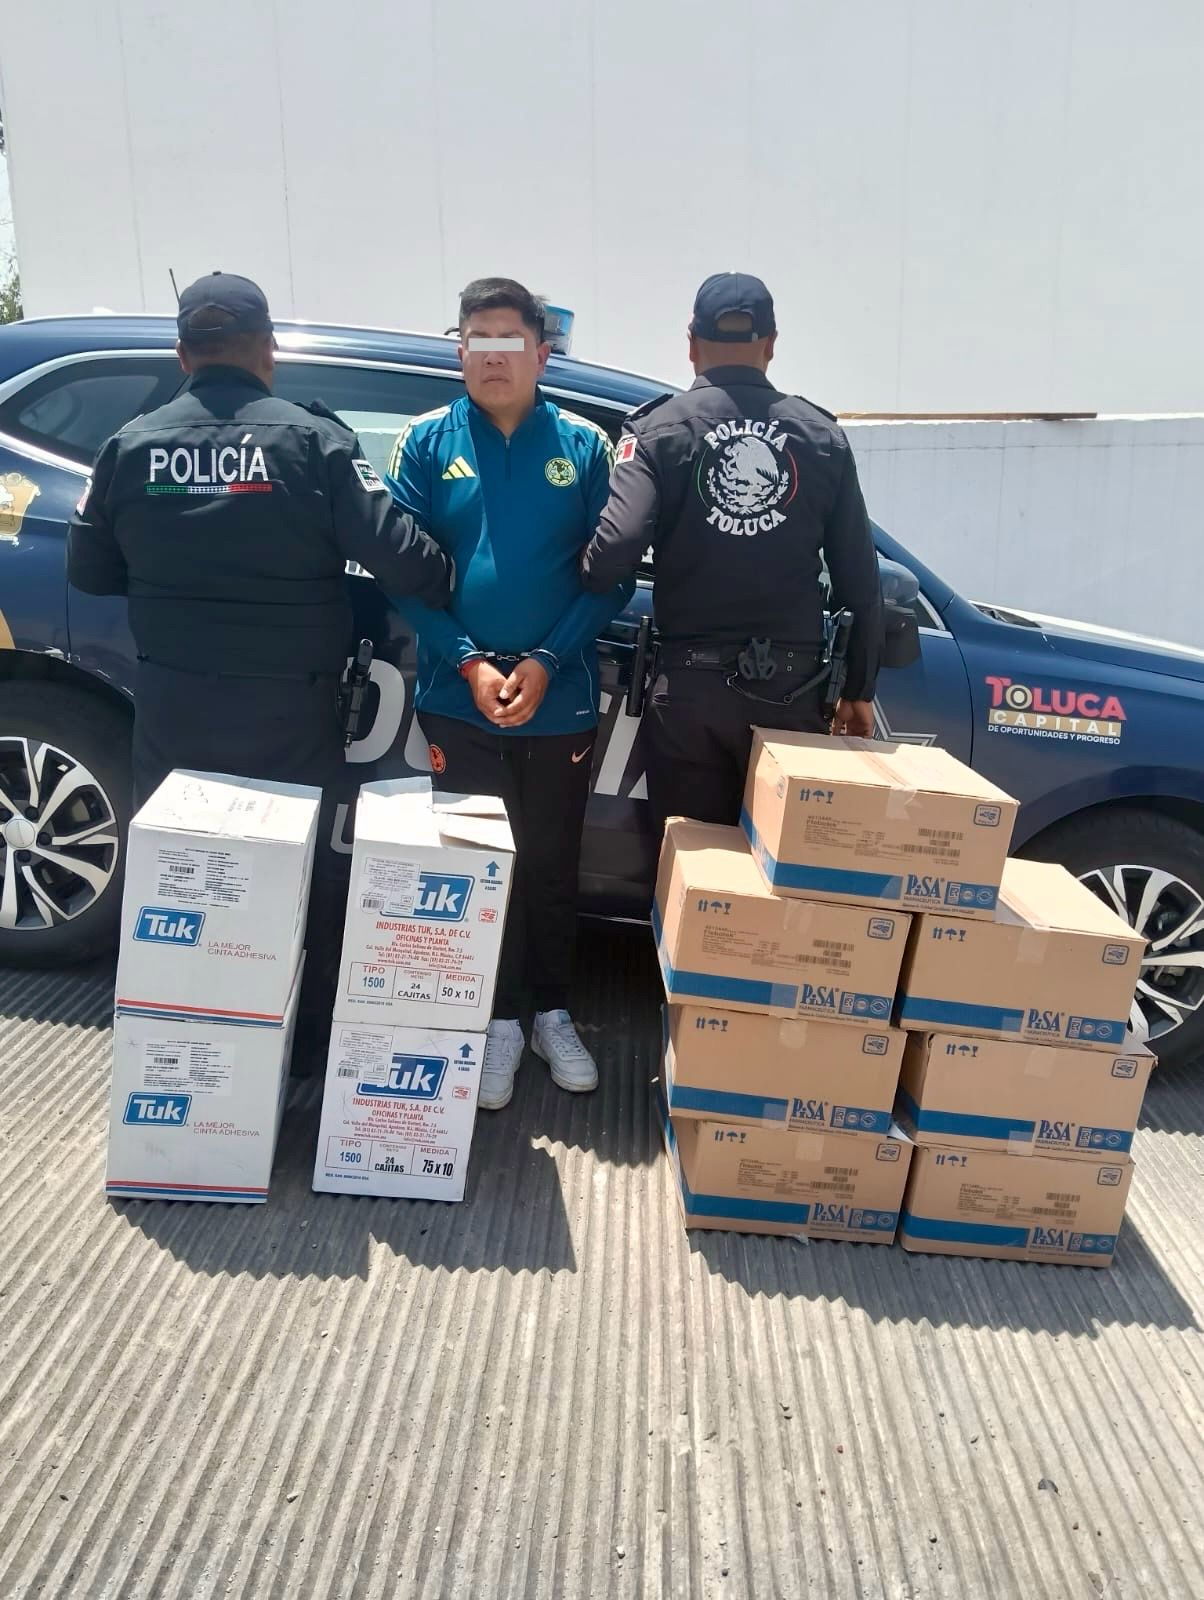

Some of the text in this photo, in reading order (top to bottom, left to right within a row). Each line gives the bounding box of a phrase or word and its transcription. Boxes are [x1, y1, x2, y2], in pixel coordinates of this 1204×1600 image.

[704, 419, 788, 452] POLICÍA
[150, 433, 269, 483] POLICÍA
[706, 506, 787, 536] TOLUCA
[985, 676, 1128, 720] TOLUCA
[993, 711, 1118, 736] CAPITAL
[988, 724, 999, 733] DE
[1000, 726, 1068, 740] OPORTUNIDADES
[1076, 734, 1121, 745] PROGRESO
[414, 882, 463, 913] uk
[144, 914, 196, 940] Tuk
[376, 921, 471, 938] INDUSTRIAS TUK, S.A. DE C.V.
[220, 942, 252, 951] MEJOR
[396, 934, 450, 946] OFICINAS Y PLANTA
[208, 948, 277, 961] CINTA ADHESIVA
[363, 965, 386, 974] TIPO
[362, 976, 385, 988] 1500
[446, 974, 476, 983] MEDIDA
[398, 990, 431, 1000] CAJITAS
[442, 986, 475, 1000] 50 x 10
[133, 1099, 183, 1121] Tuk
[352, 1097, 445, 1114] INDUSTRIAS TUK, S.A. DE C.V.
[372, 1110, 398, 1118] OFICINAS
[404, 1112, 424, 1120] PLANTA
[194, 1128, 260, 1137] CINTA ADHESIVA
[206, 1122, 235, 1130] MEJOR
[340, 1140, 362, 1148] TIPO
[340, 1151, 362, 1164] 1500
[420, 1147, 450, 1156] MEDIDA
[385, 1156, 395, 1164] 24
[374, 1163, 404, 1173] CAJITAS
[422, 1159, 454, 1177] 75 x 10
